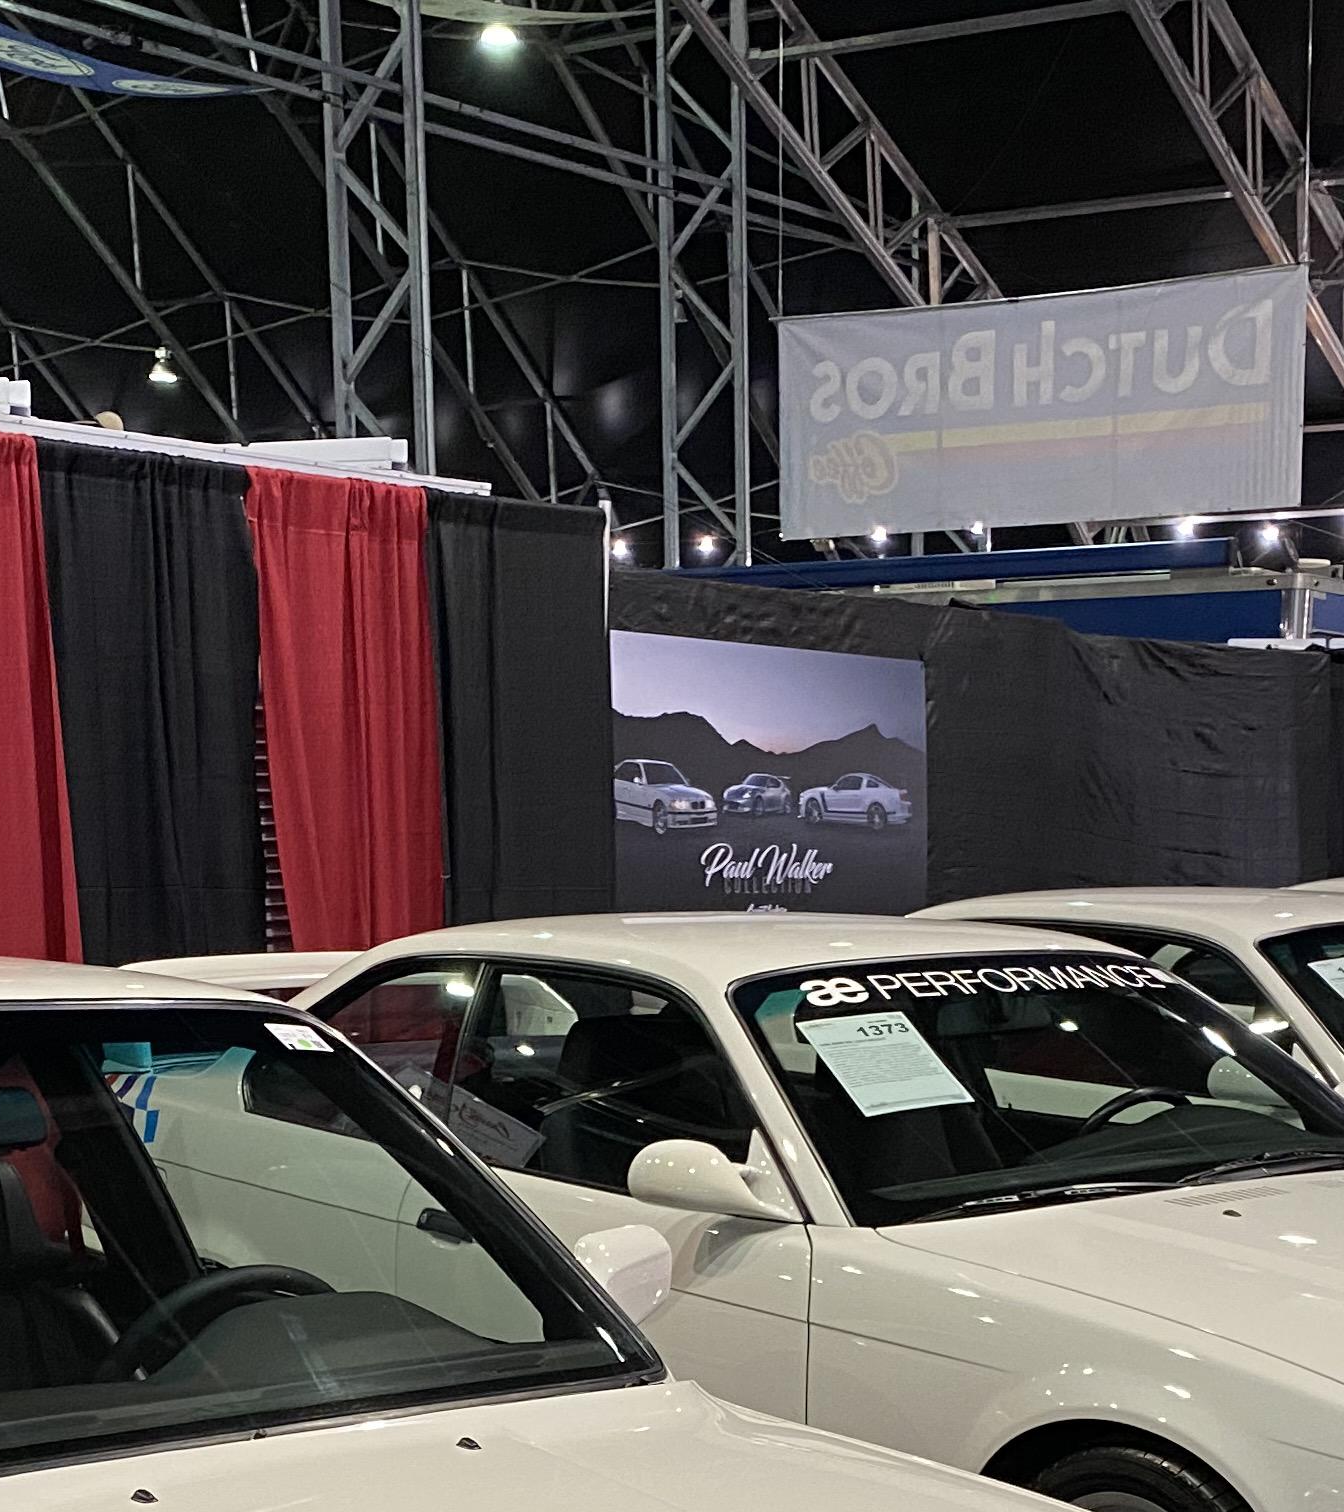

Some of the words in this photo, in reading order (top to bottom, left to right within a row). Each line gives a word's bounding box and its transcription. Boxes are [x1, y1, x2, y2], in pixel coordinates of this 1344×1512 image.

[700, 842, 760, 887] Paul
[758, 843, 834, 885] Walker
[866, 965, 1167, 1001] PERFORMANCE
[856, 1022, 910, 1037] 1373
